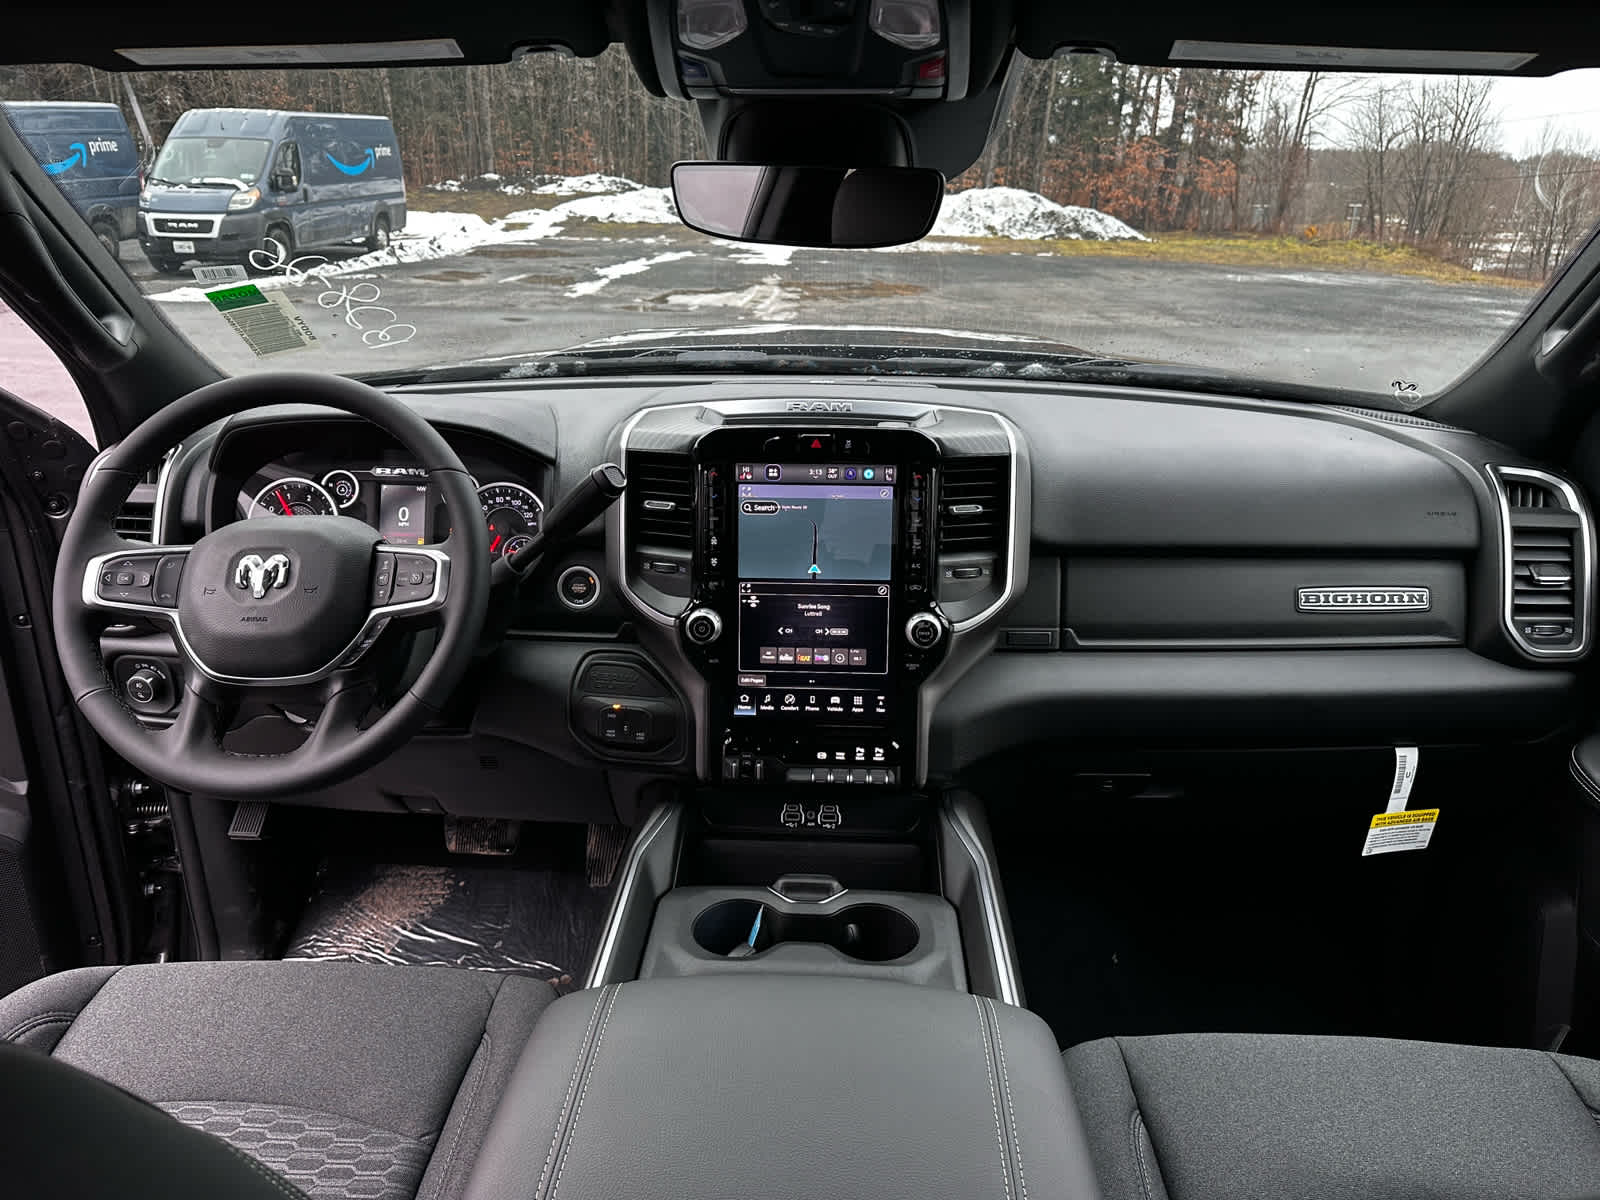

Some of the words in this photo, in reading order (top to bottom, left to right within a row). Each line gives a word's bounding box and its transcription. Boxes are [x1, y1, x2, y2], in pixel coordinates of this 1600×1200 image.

[88, 137, 118, 156] prime
[374, 143, 392, 160] prime
[785, 400, 854, 411] RAM
[398, 506, 409, 522] 0
[1301, 592, 1427, 605] BIGHORN
